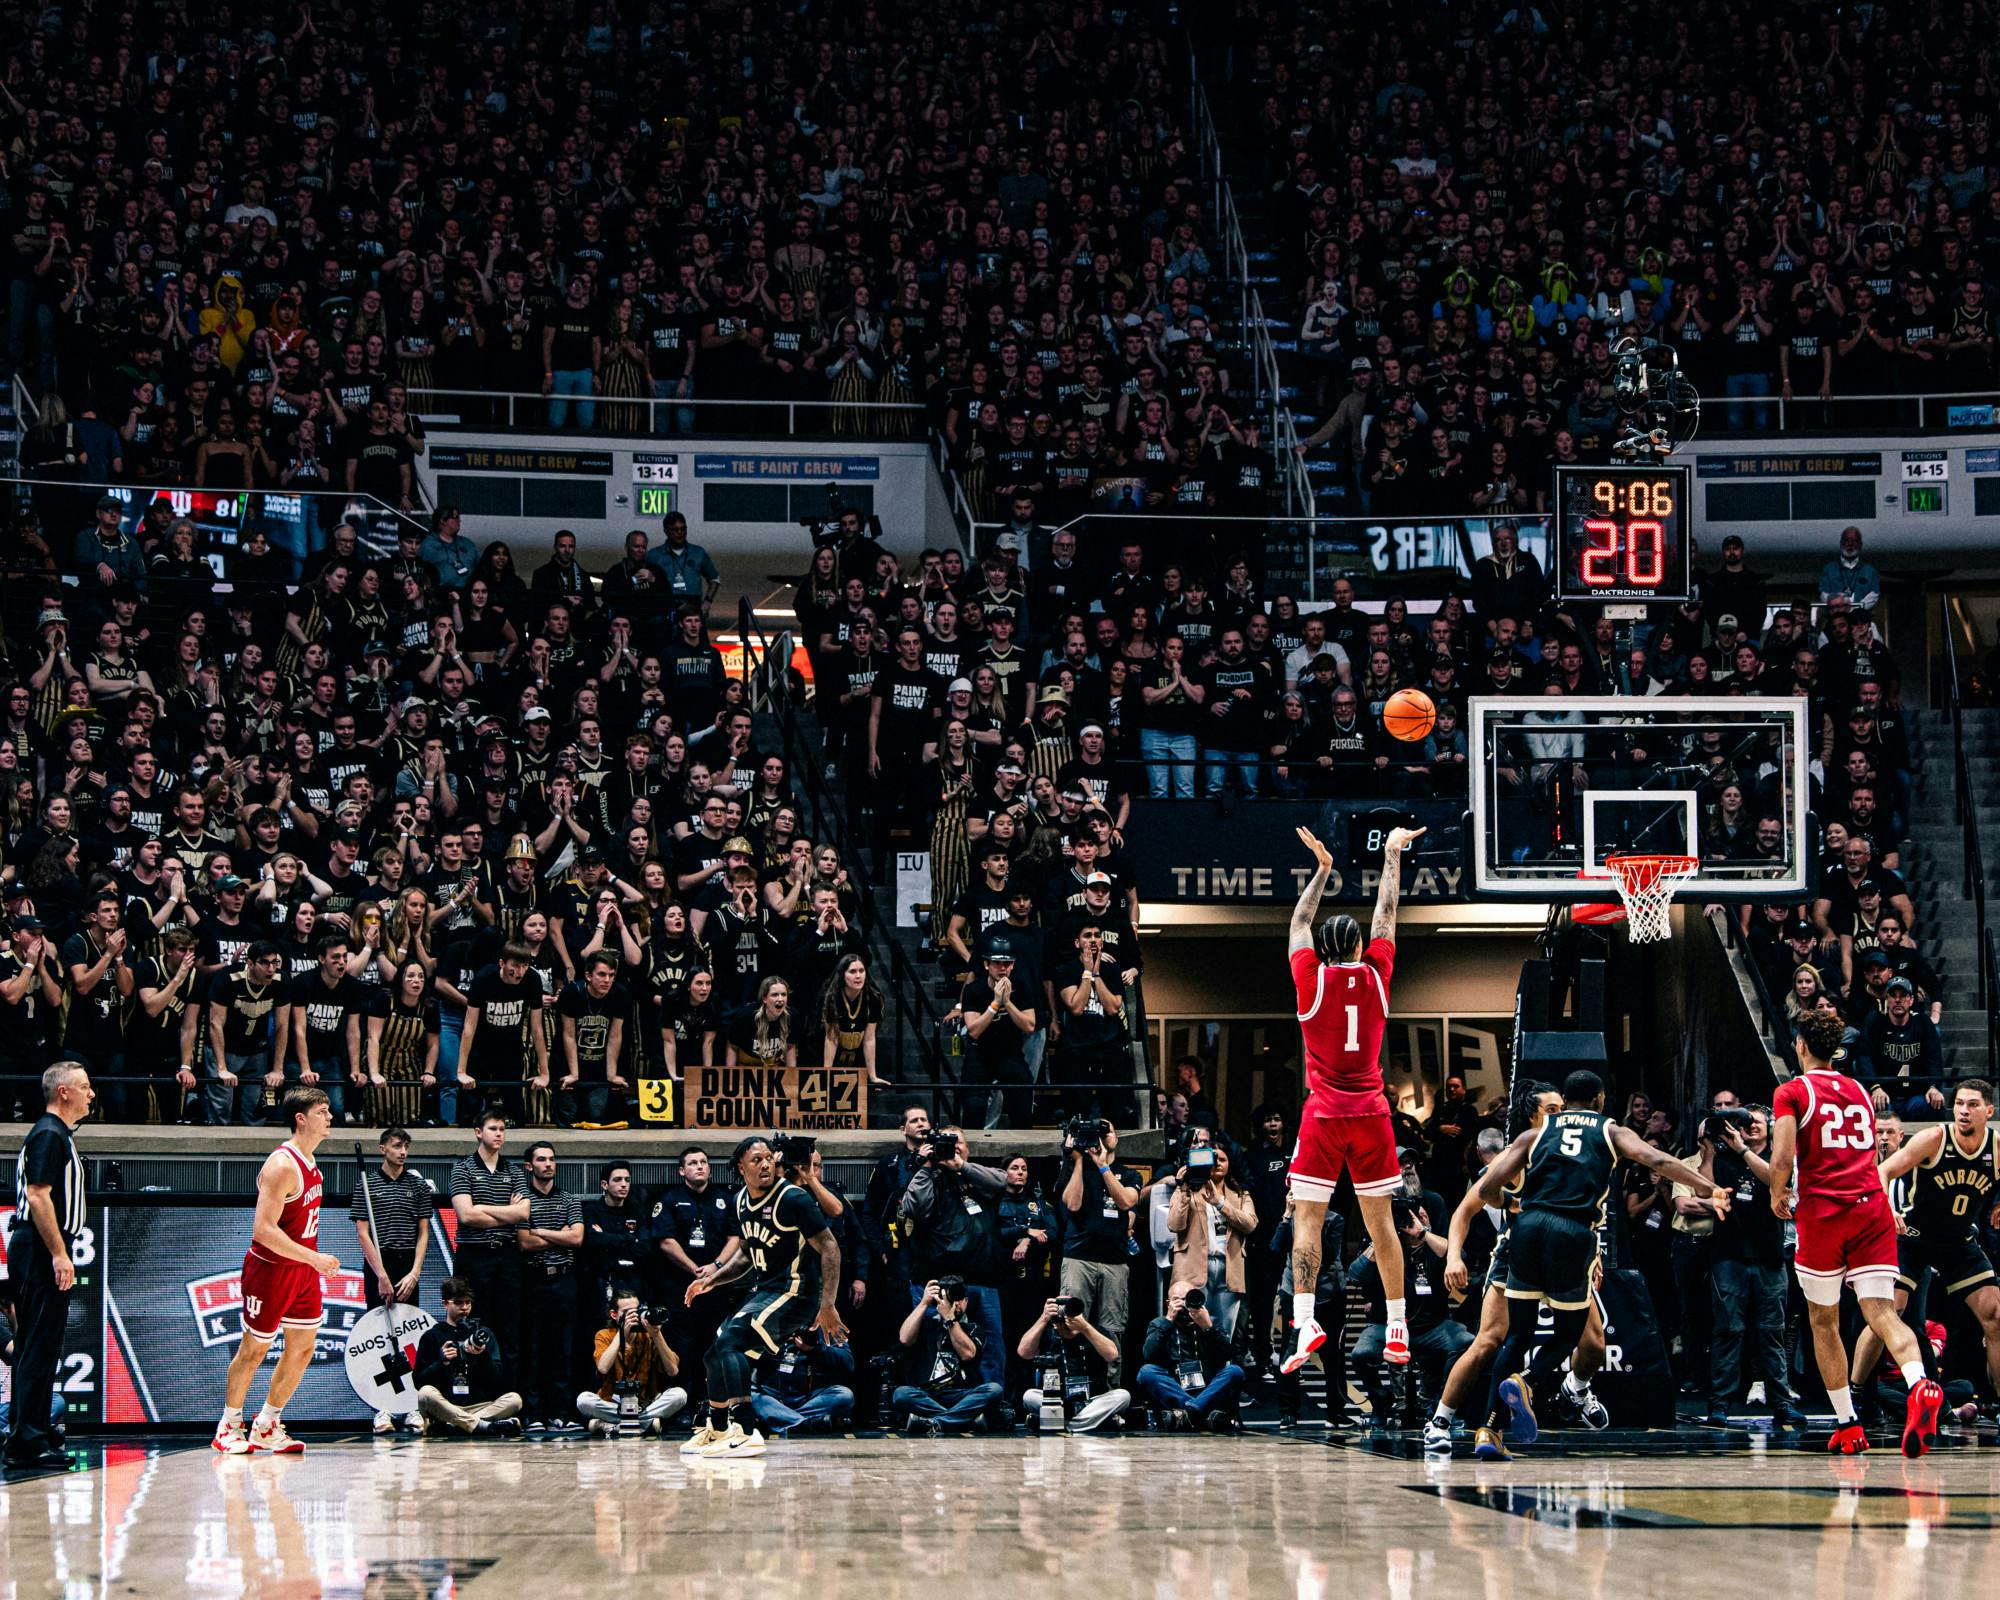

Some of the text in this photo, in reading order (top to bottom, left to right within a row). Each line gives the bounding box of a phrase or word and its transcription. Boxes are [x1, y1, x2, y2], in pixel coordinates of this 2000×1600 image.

[653, 328, 680, 340] PAINT
[774, 332, 800, 343] PAINT
[340, 386, 371, 398] PAINT
[466, 453, 490, 466] THE
[495, 454, 533, 468] PAINT
[538, 456, 577, 469] CREW
[731, 460, 756, 473] THE
[760, 462, 799, 474] PAINT
[804, 462, 843, 474] CREW
[1733, 460, 1756, 472] THE
[1762, 459, 1800, 472] PAINT
[1806, 458, 1845, 472] CREW
[637, 467, 674, 478] 13-14
[1906, 465, 1944, 477] 14-15
[641, 489, 668, 514] EXIT
[1594, 480, 1672, 517] 9:06
[1582, 521, 1664, 586] 20
[926, 653, 960, 665] PAINT
[894, 684, 928, 698] PAINT
[892, 696, 925, 710] CREW
[1330, 738, 1365, 752] PURDUE
[330, 764, 367, 780] PAINT
[130, 810, 163, 825] PAINT
[1170, 867, 1273, 896] TIME
[1290, 868, 1343, 897] TO
[980, 908, 1010, 922] PAIN
[736, 954, 758, 973] 34
[652, 967, 687, 988] PURD
[306, 1002, 344, 1017] PAINT
[487, 1000, 524, 1014] PAINT
[486, 1013, 523, 1026] CREW
[1344, 1004, 1360, 1052] 1
[646, 1081, 668, 1114] 3
[702, 1068, 858, 1112] DUNK 47
[696, 1099, 862, 1129] COUNT IN MACKEY
[1556, 1114, 1598, 1128] NEWMAN
[1820, 1104, 1875, 1150] 23
[1560, 1128, 1583, 1156] 5
[1934, 1168, 1993, 1196] PURDUE
[1952, 1194, 1970, 1216] 0
